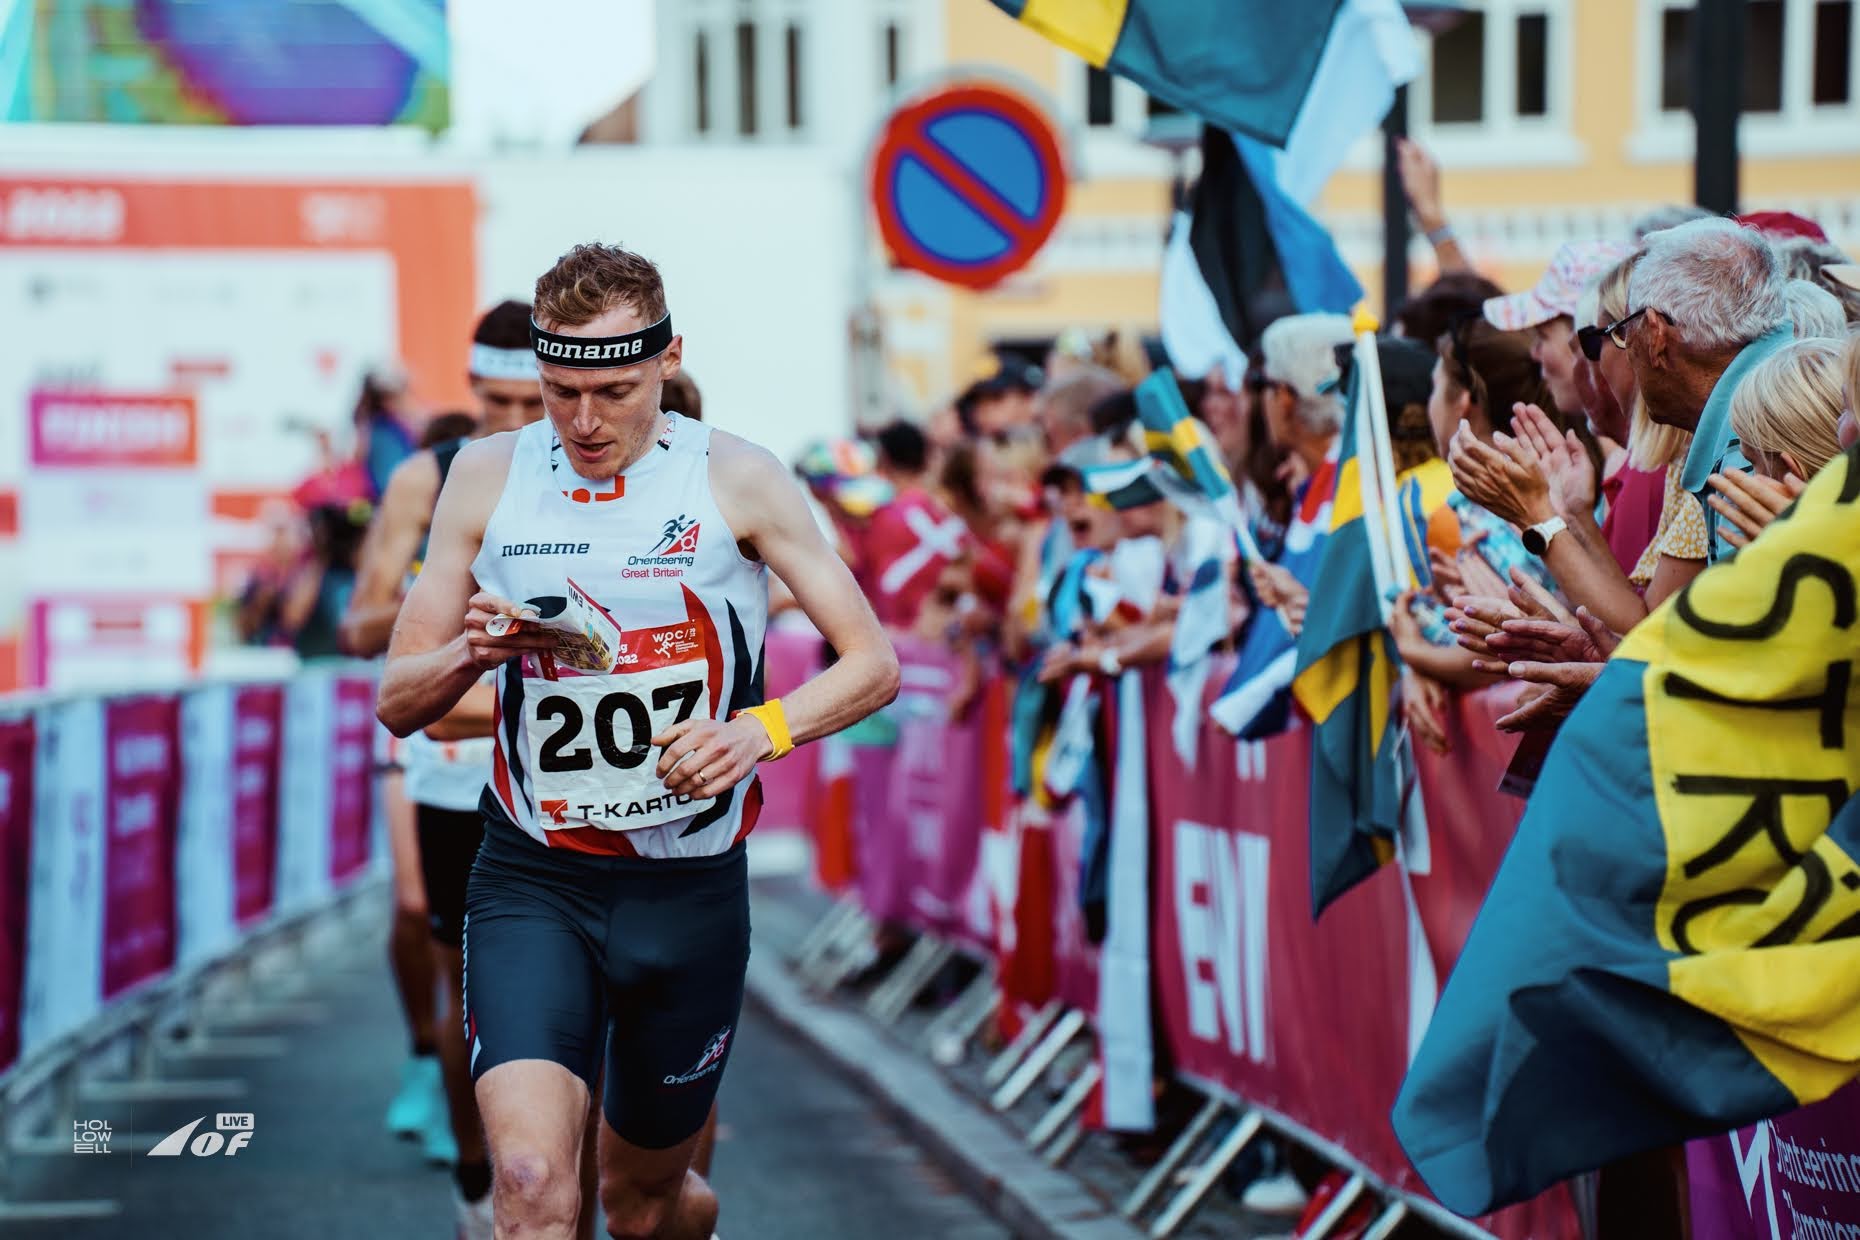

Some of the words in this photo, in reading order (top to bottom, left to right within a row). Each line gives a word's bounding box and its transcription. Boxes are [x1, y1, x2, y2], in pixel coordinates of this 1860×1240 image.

[536, 337, 643, 360] noname
[502, 542, 590, 557] noname
[627, 555, 694, 567] Orienteering
[621, 568, 650, 579] Great
[653, 567, 683, 578] Britain
[617, 653, 639, 665] 022
[536, 680, 704, 773] 207
[577, 792, 693, 820] T-KARTO
